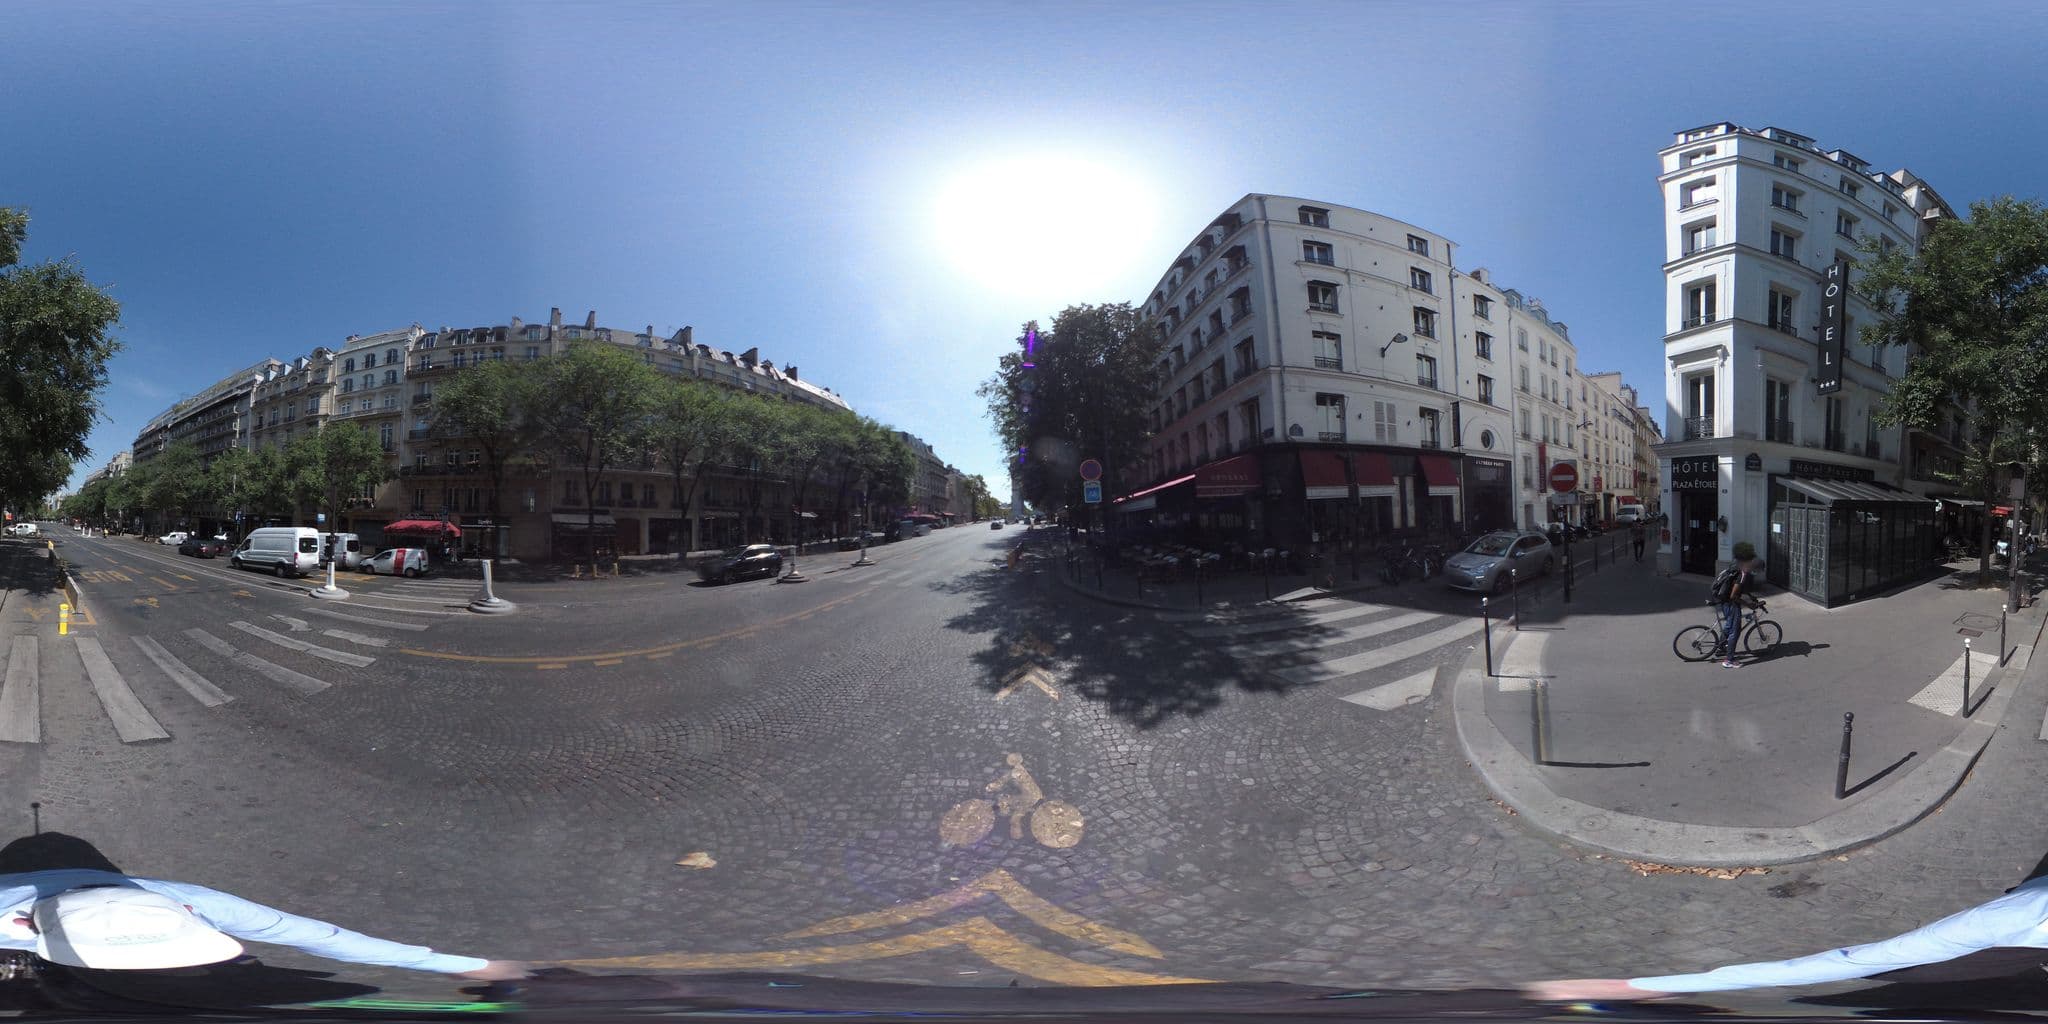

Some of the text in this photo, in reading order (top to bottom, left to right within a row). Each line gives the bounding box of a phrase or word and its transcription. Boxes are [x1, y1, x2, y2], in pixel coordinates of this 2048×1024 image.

[1825, 266, 1838, 365] HÔTEL
[1672, 461, 1717, 473] HÔTEL
[1672, 478, 1718, 489] PLAZA ÉTOILE
[80, 570, 132, 583] BUS
